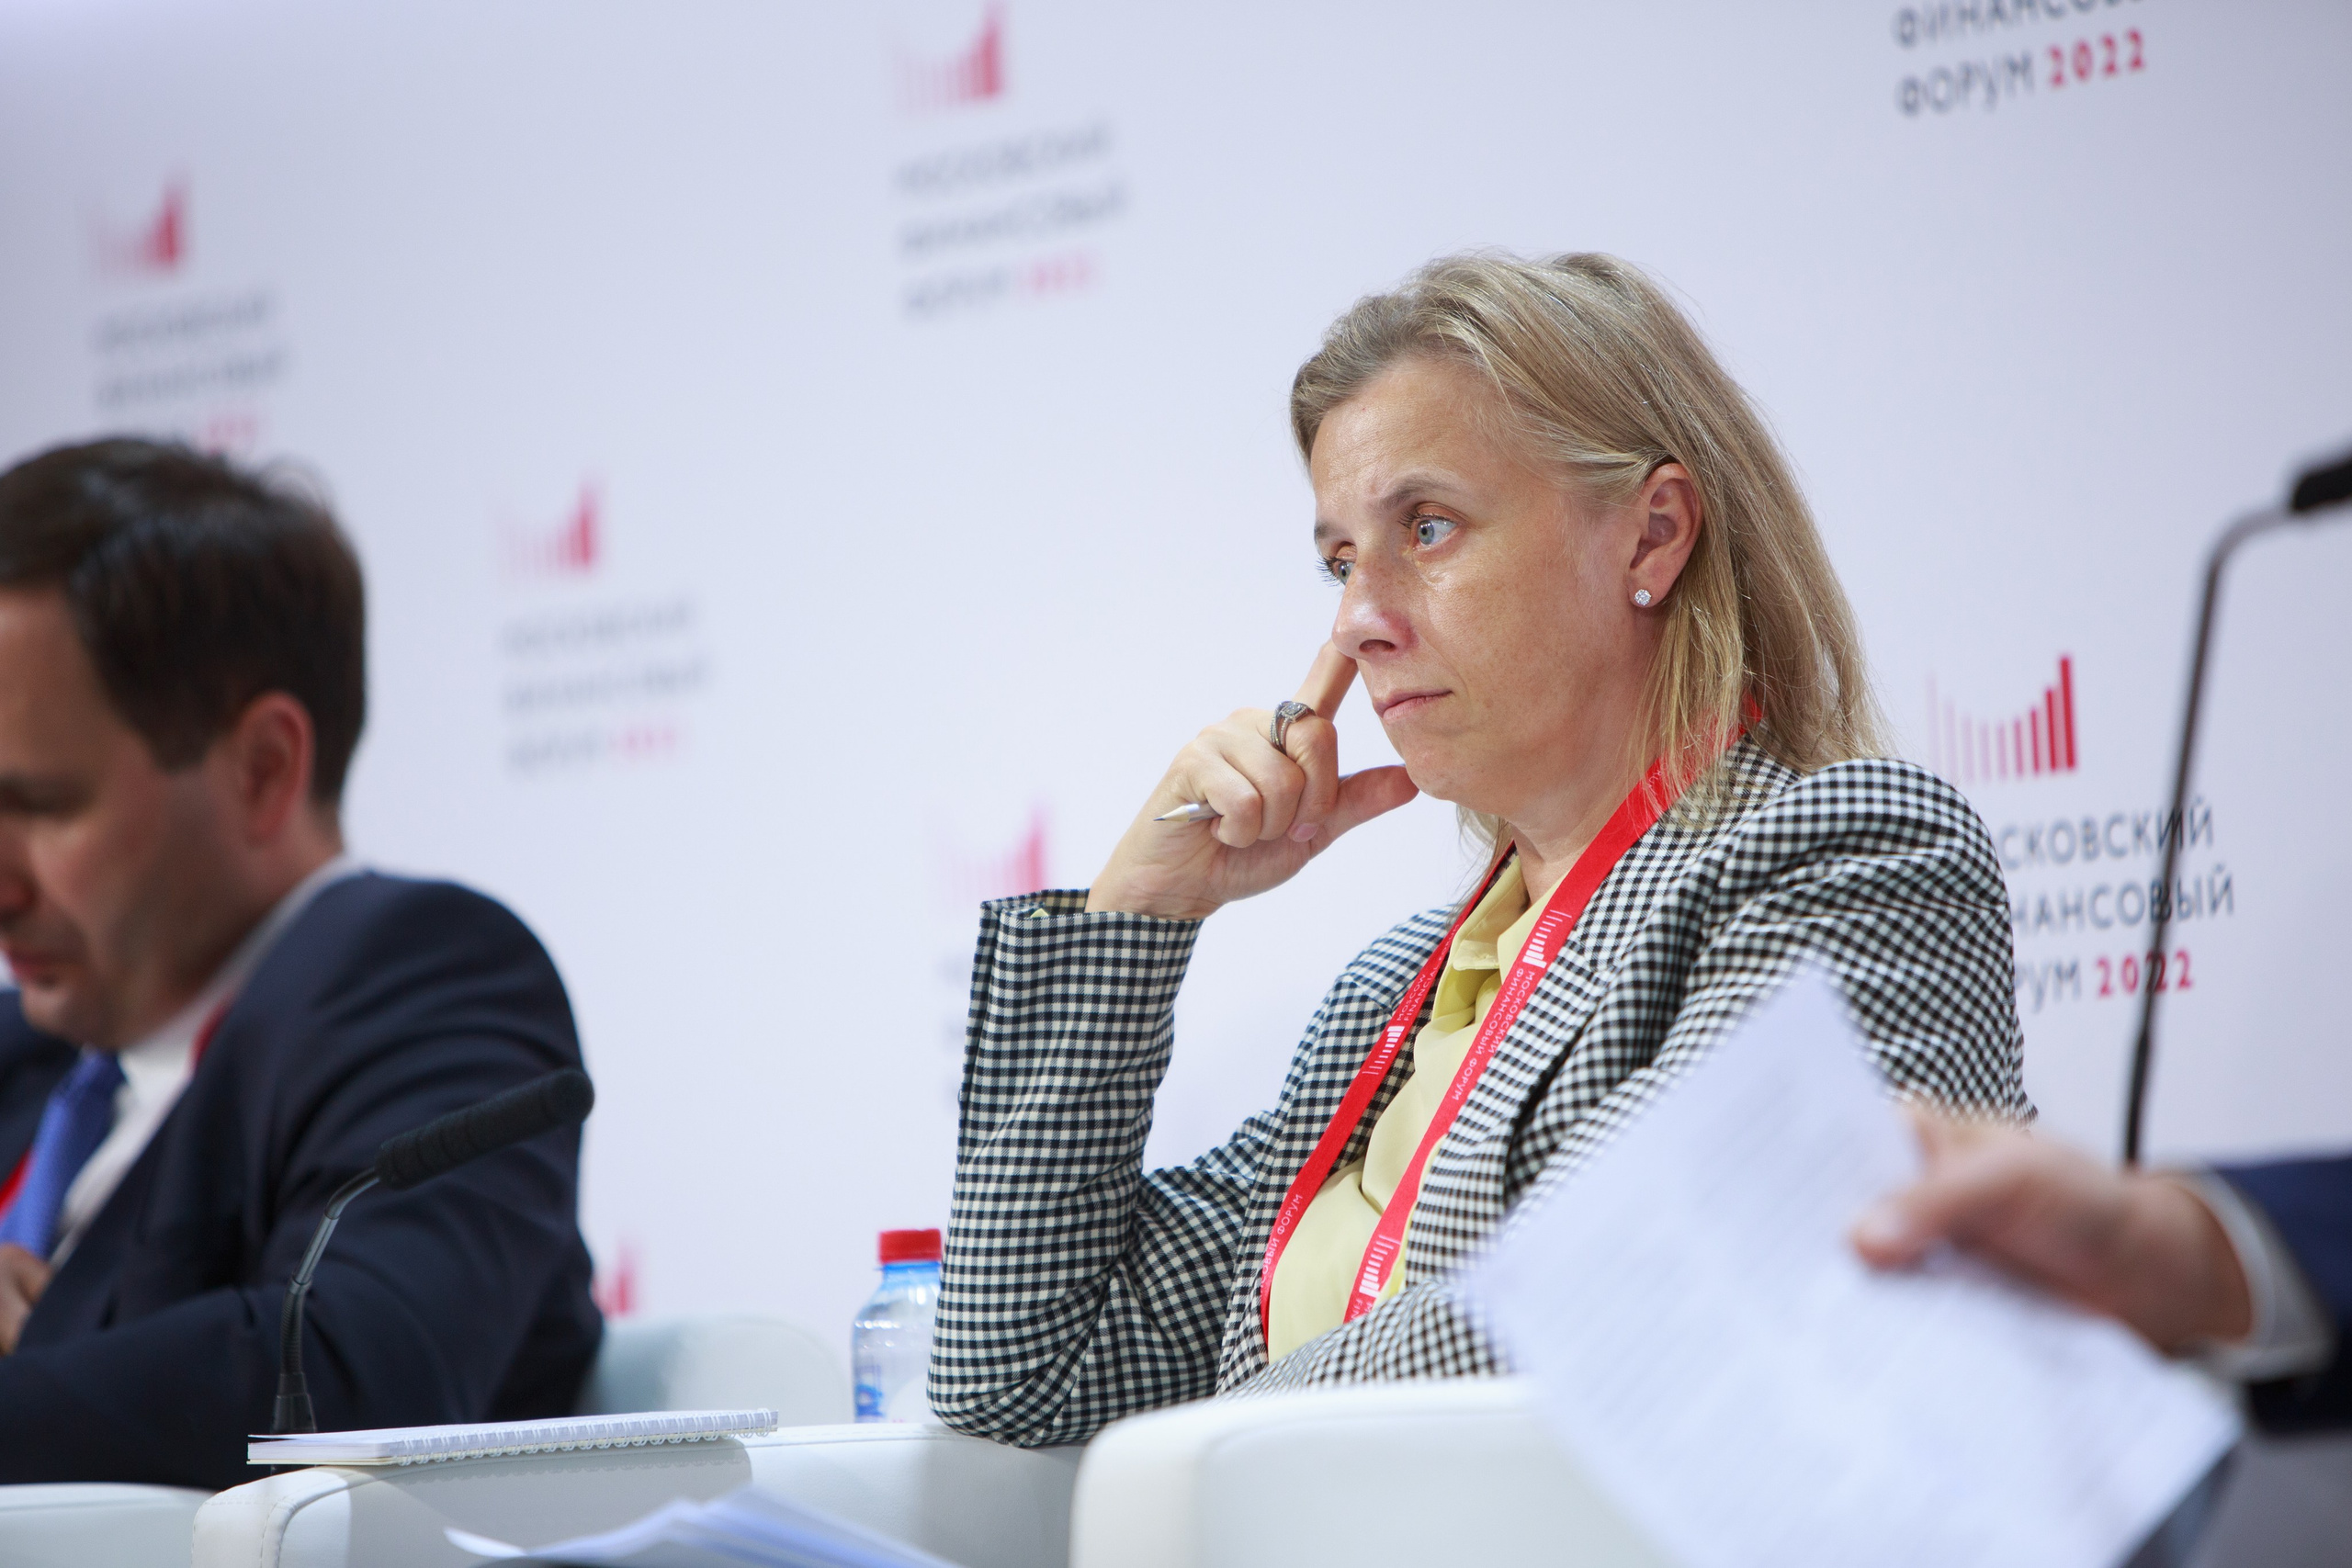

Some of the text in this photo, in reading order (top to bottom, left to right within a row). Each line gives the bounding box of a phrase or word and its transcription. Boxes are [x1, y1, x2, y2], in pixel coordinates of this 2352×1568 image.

[1896, 28, 2145, 117] ФОРУМ 2022
[1998, 795, 2213, 870] СКОВСКИЙ
[2010, 862, 2234, 932] НАНСОВЫЙ
[1396, 974, 1426, 1021] MOSCOW
[1404, 966, 1440, 1021] FINANCIAL
[2013, 948, 2193, 1013] РУМ 2022
[1452, 1058, 1476, 1100] ФОРУМ
[1277, 1193, 1303, 1235] ФОРУМ
